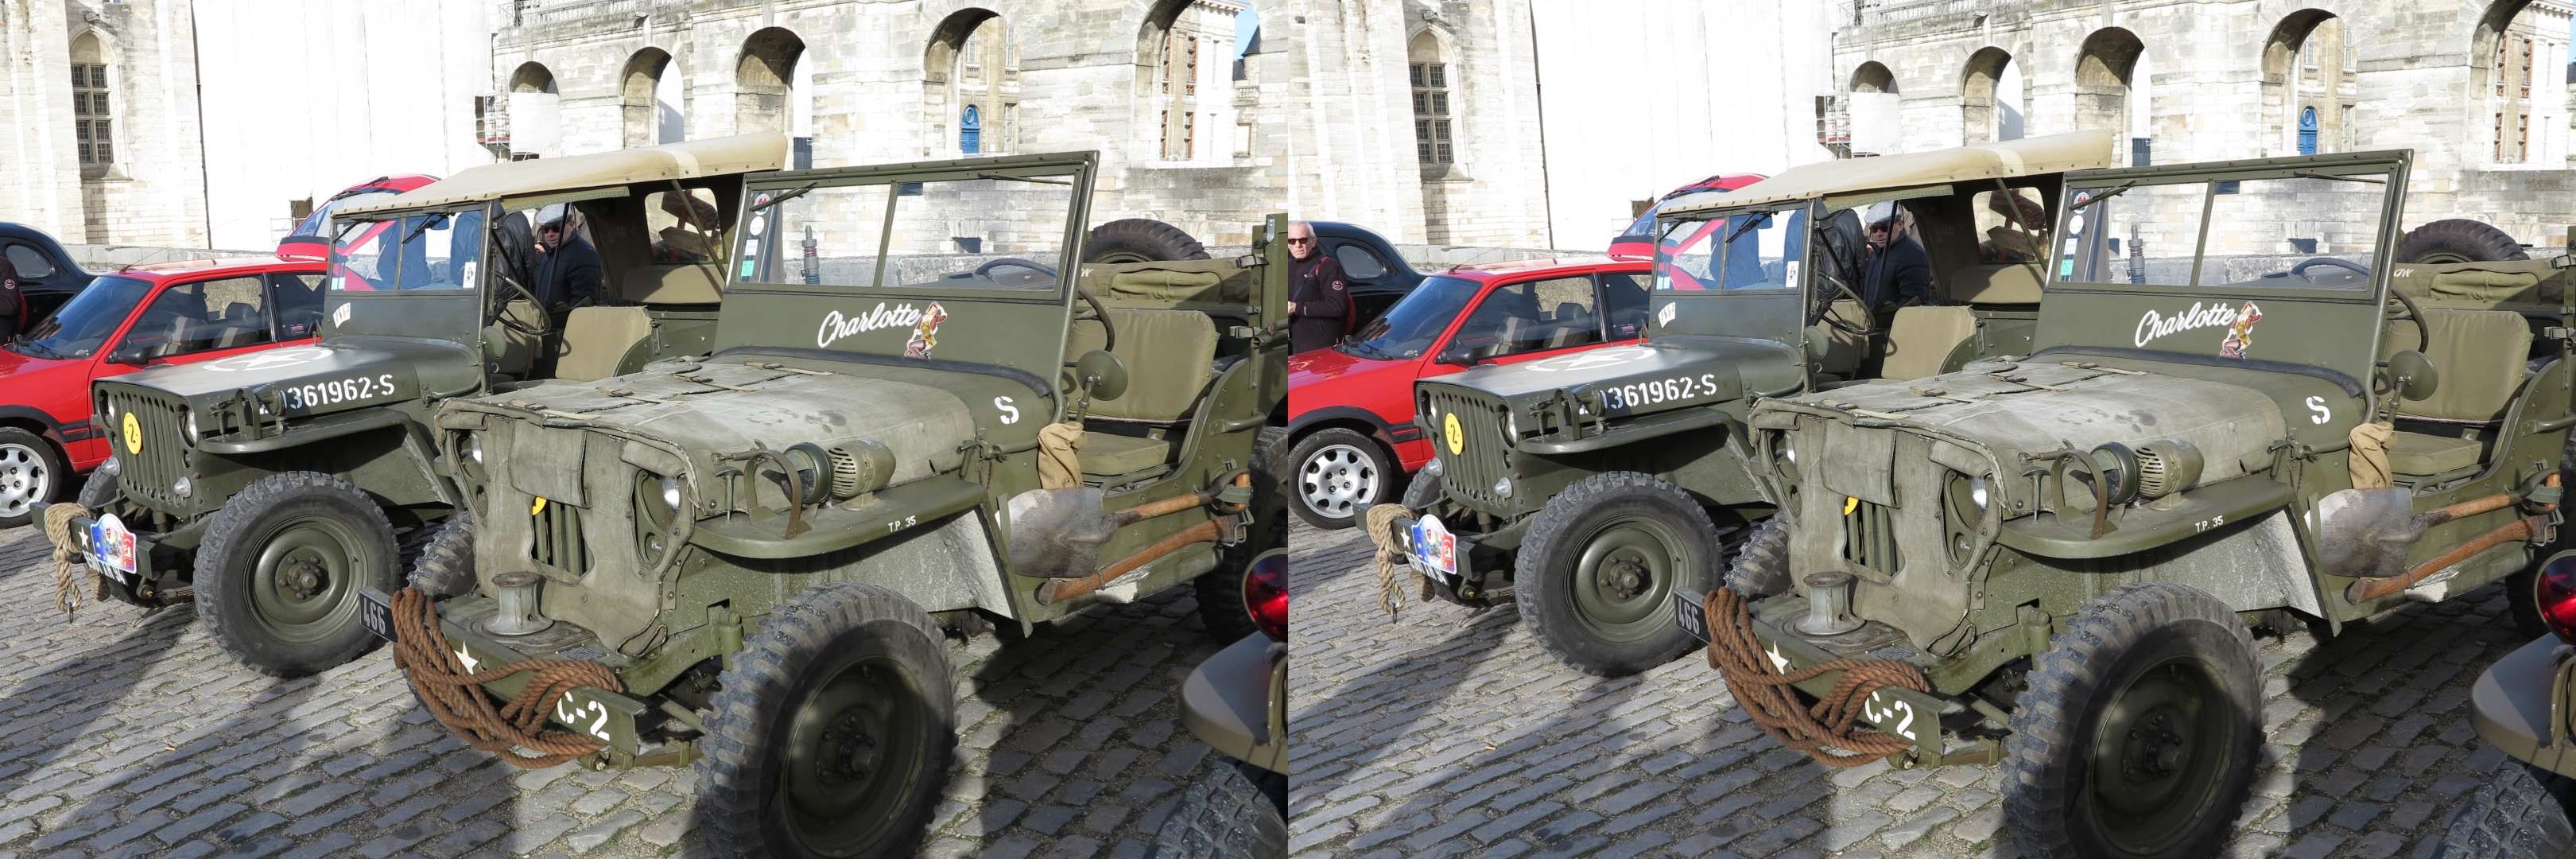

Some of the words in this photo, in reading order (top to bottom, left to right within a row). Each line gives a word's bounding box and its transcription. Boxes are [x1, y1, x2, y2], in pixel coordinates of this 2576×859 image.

[817, 302, 922, 348] Charlotte
[2135, 301, 2237, 348] Charlotte
[259, 374, 394, 414] 361962-S
[994, 396, 1019, 425] S
[2306, 396, 2331, 425] S
[129, 422, 136, 443] 2
[1450, 423, 1457, 444] 2
[888, 520, 902, 532] T.P.
[906, 515, 916, 527] 35
[2195, 520, 2209, 532] T.P.
[2213, 515, 2223, 527] 35
[363, 597, 386, 635] 466
[1678, 597, 1700, 635] 466
[557, 690, 610, 741] C-2
[1864, 690, 1916, 740] C-2
